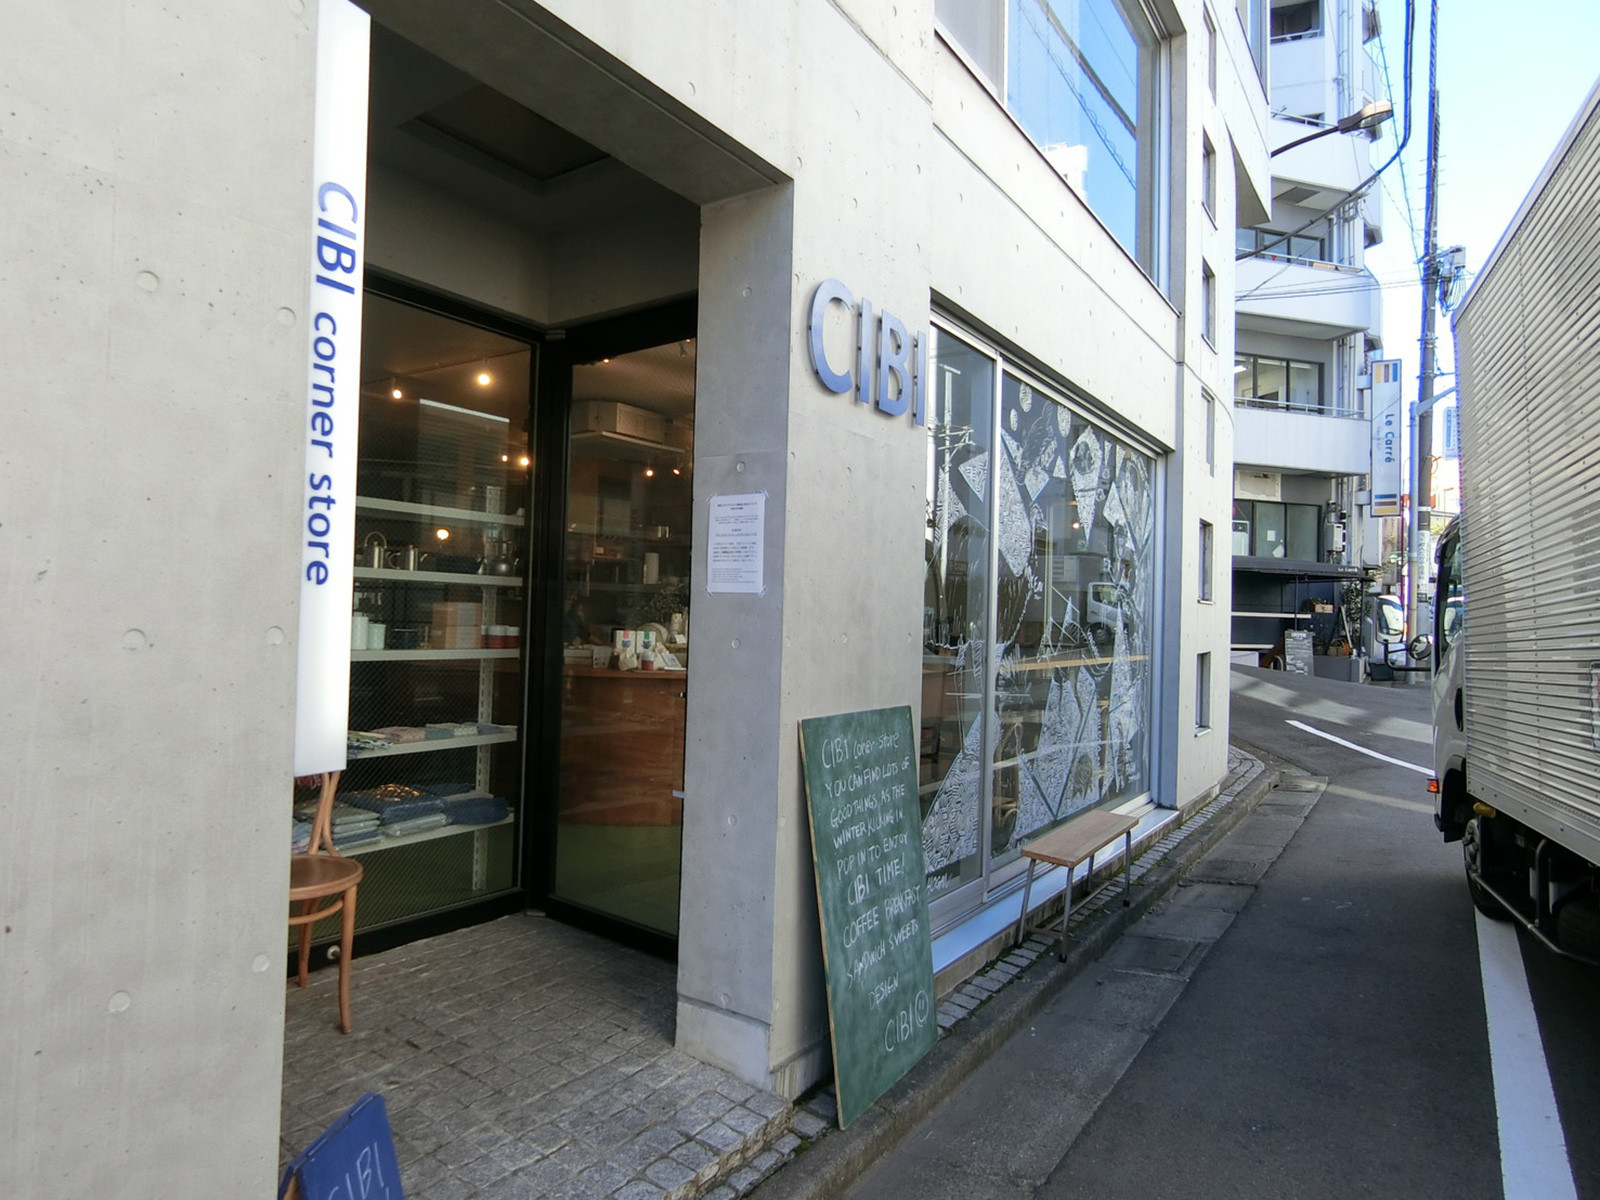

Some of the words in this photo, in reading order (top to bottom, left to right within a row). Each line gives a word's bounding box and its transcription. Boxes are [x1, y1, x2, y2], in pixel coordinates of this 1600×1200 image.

[316, 181, 359, 295] CIBI
[807, 278, 926, 427] CIBI
[310, 312, 337, 458] corner
[1385, 414, 1395, 426] Le
[1385, 431, 1396, 463] Carré
[306, 473, 337, 585] store
[822, 737, 849, 768] CIBI
[824, 780, 847, 798] YOU
[848, 773, 863, 792] CAN
[863, 766, 882, 784] FIND
[882, 761, 899, 779] LOTS
[830, 803, 853, 828] GOOD
[881, 787, 890, 805] AS
[892, 783, 905, 799] THE
[833, 821, 867, 850] WINTER
[836, 854, 855, 880] POP
[857, 849, 867, 867] IN
[868, 844, 882, 862] TO
[883, 832, 908, 853] ENJOY
[847, 872, 870, 906] CIBI
[875, 852, 905, 886] TIME!
[843, 906, 880, 949] COFFEE
[846, 938, 886, 990] SANDWICH
[888, 918, 919, 951] SWEETS
[868, 971, 899, 1010] DESIGN
[884, 1002, 913, 1052] CIBI
